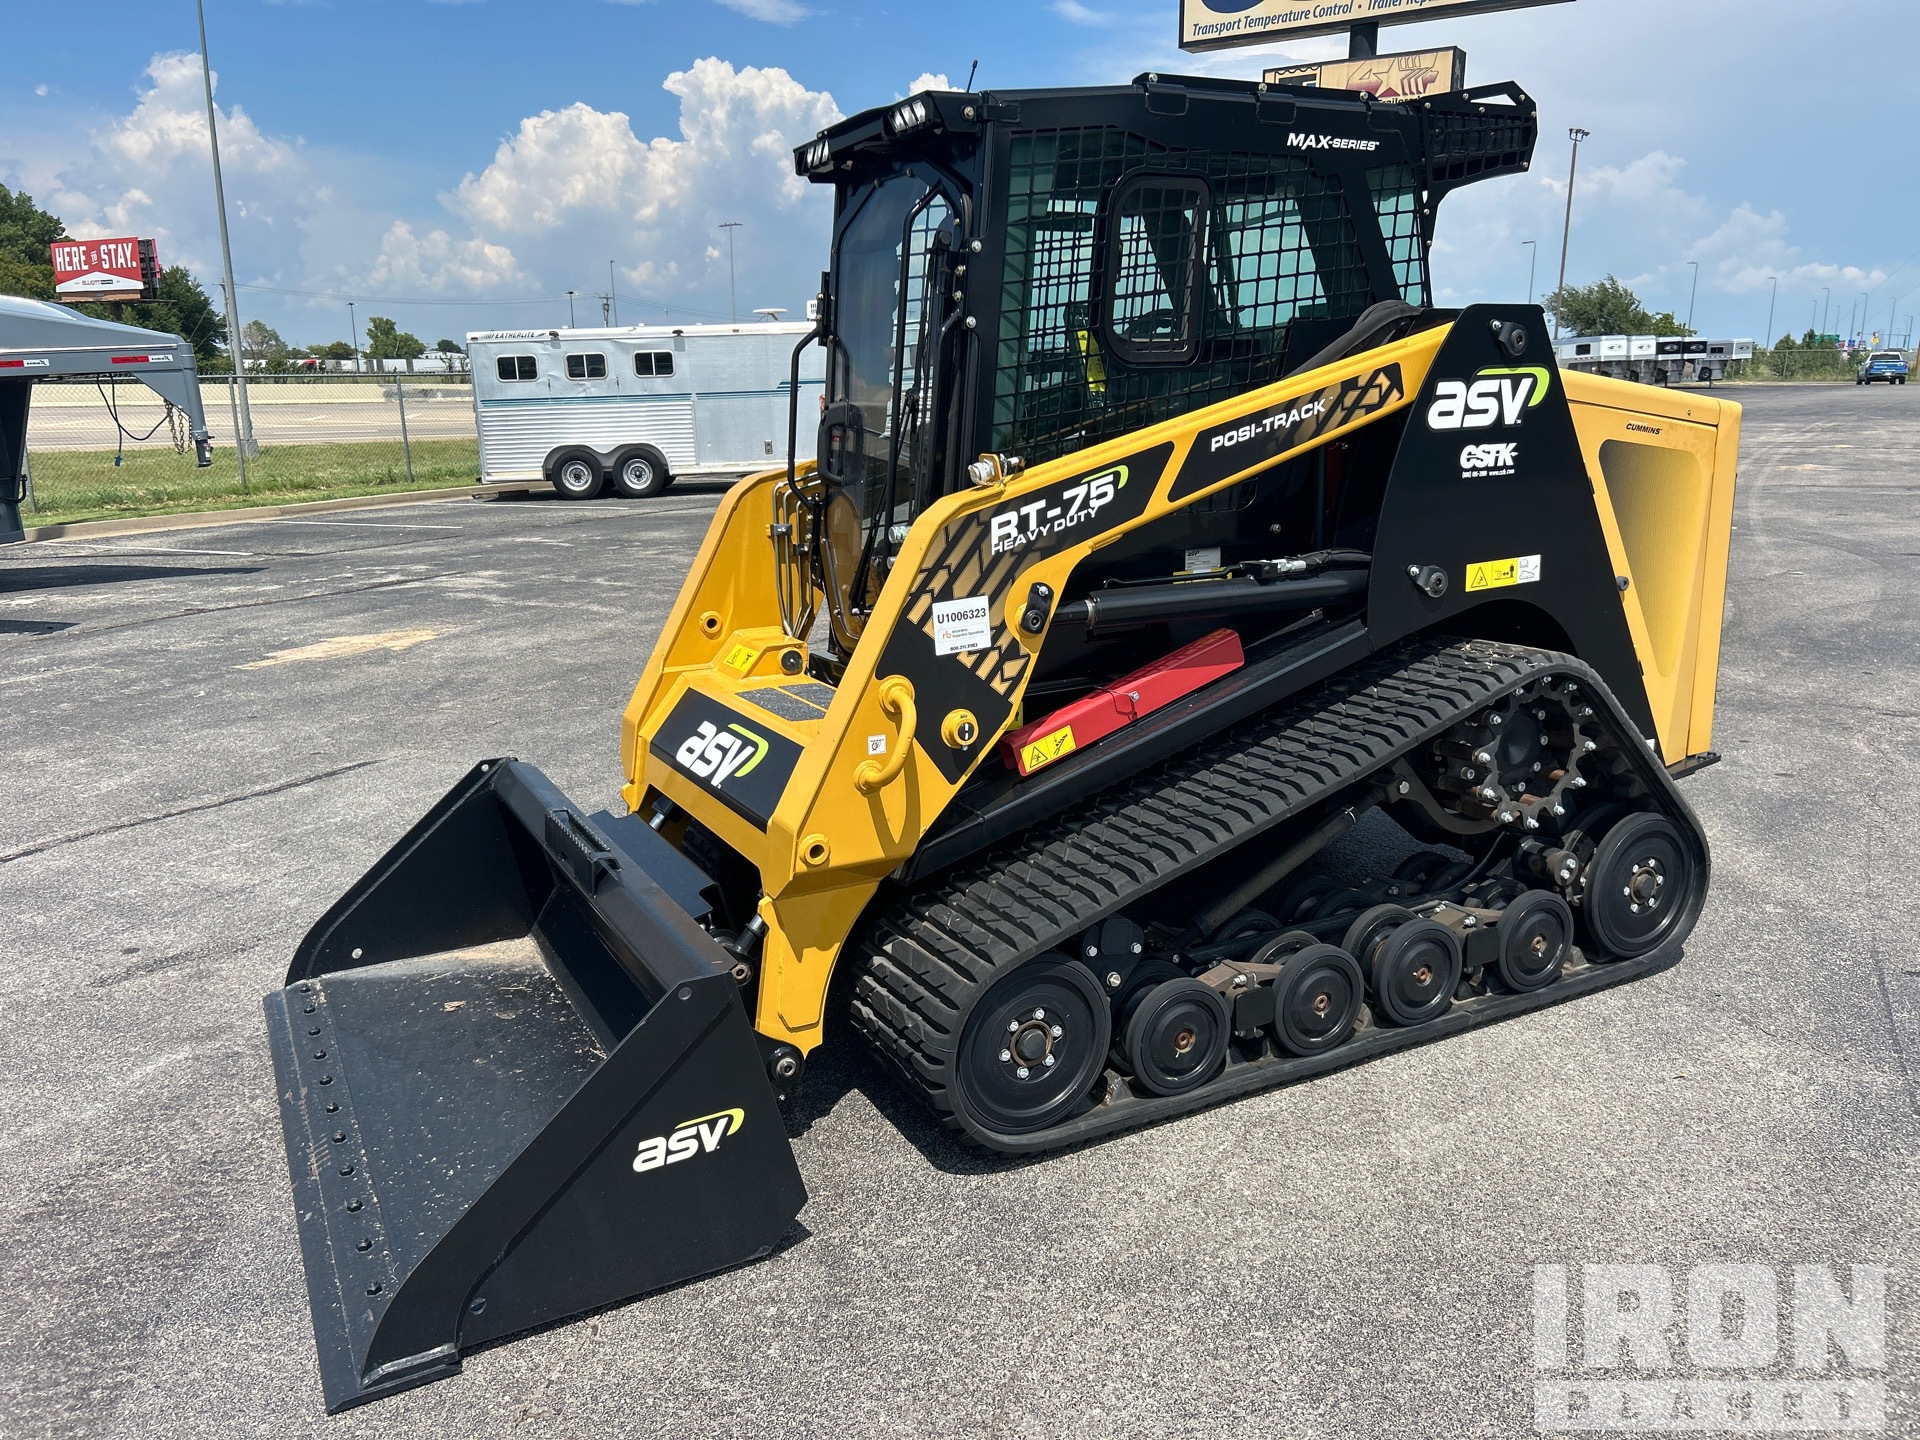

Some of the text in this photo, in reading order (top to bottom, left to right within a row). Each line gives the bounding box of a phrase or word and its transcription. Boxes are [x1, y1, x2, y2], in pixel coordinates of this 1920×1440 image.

[1193, 17, 1242, 36] Transport
[1244, 9, 1311, 29] Temperature
[1313, 0, 1353, 18] Control
[55, 245, 89, 271] HERE
[100, 242, 137, 270] STAY.
[1626, 423, 1661, 435] CUMMINS
[991, 473, 1115, 547] RT-75
[991, 505, 1099, 556] HEAVY DUTY
[937, 607, 987, 624] U1006323
